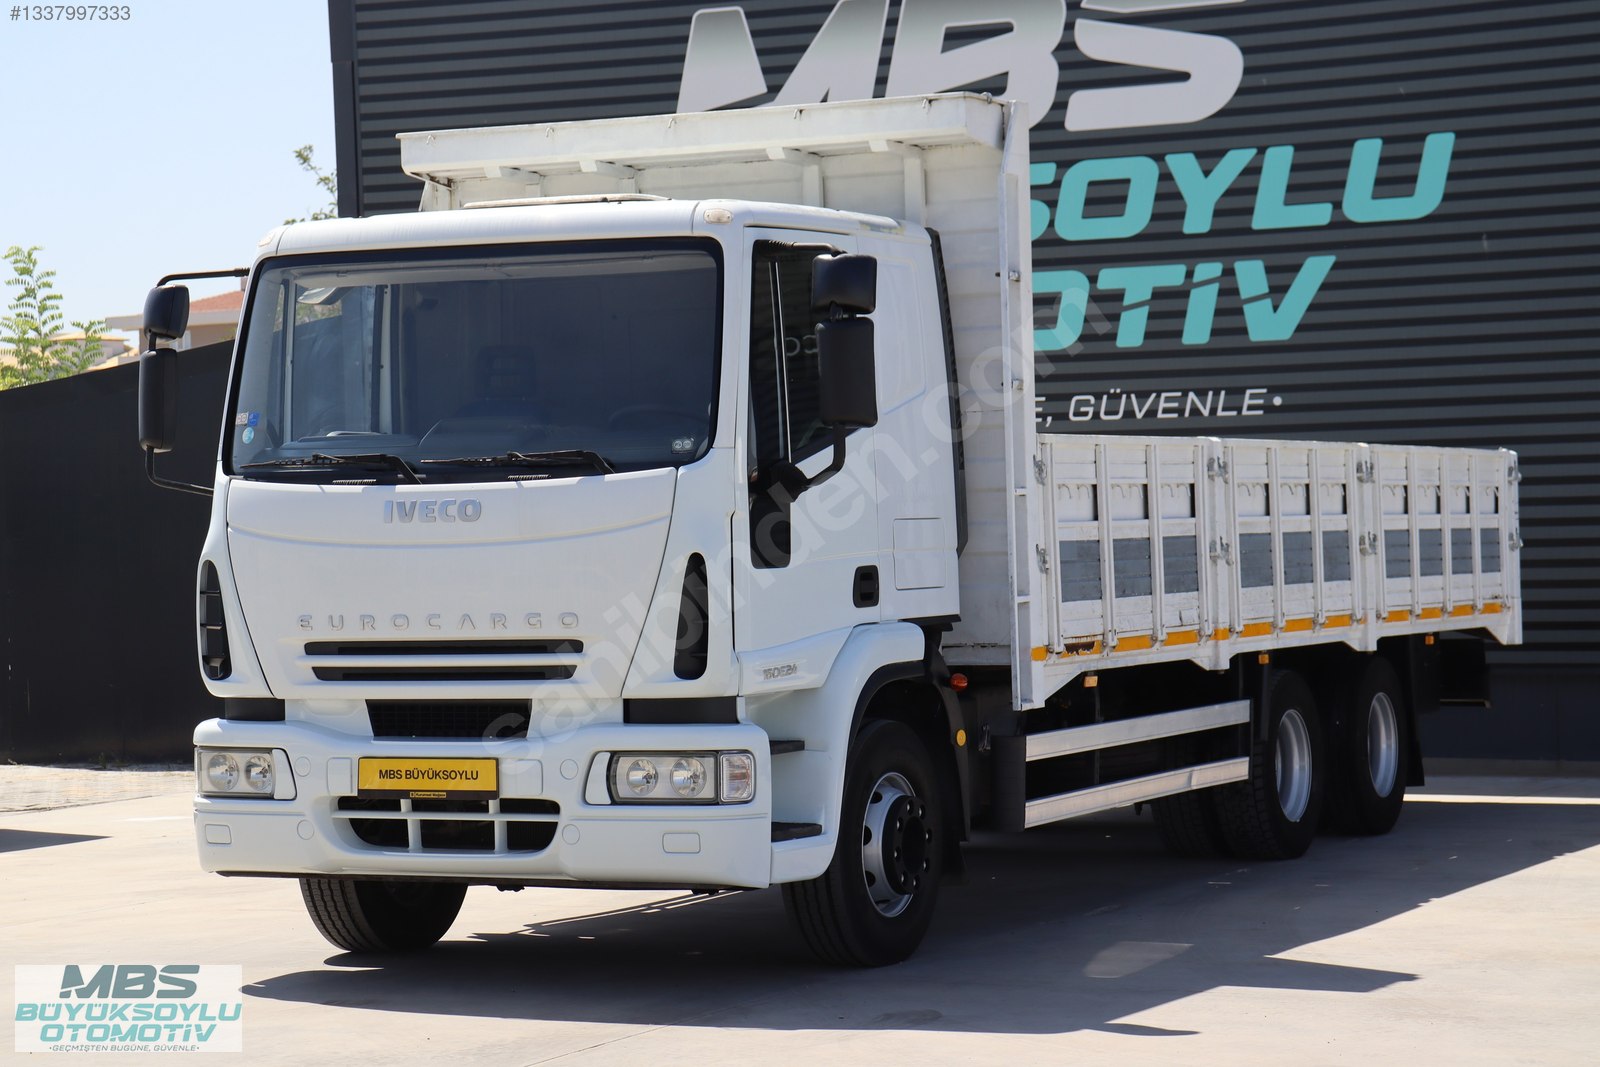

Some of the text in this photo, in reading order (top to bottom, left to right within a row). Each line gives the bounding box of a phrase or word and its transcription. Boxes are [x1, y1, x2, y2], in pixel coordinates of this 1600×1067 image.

[676, 0, 1245, 132] MBS
[1030, 131, 1457, 242] OYLU
[383, 499, 482, 523] IVECO
[297, 611, 580, 632] EUROCARGO
[378, 767, 479, 780] MBS BÜYÜKSOYLU
